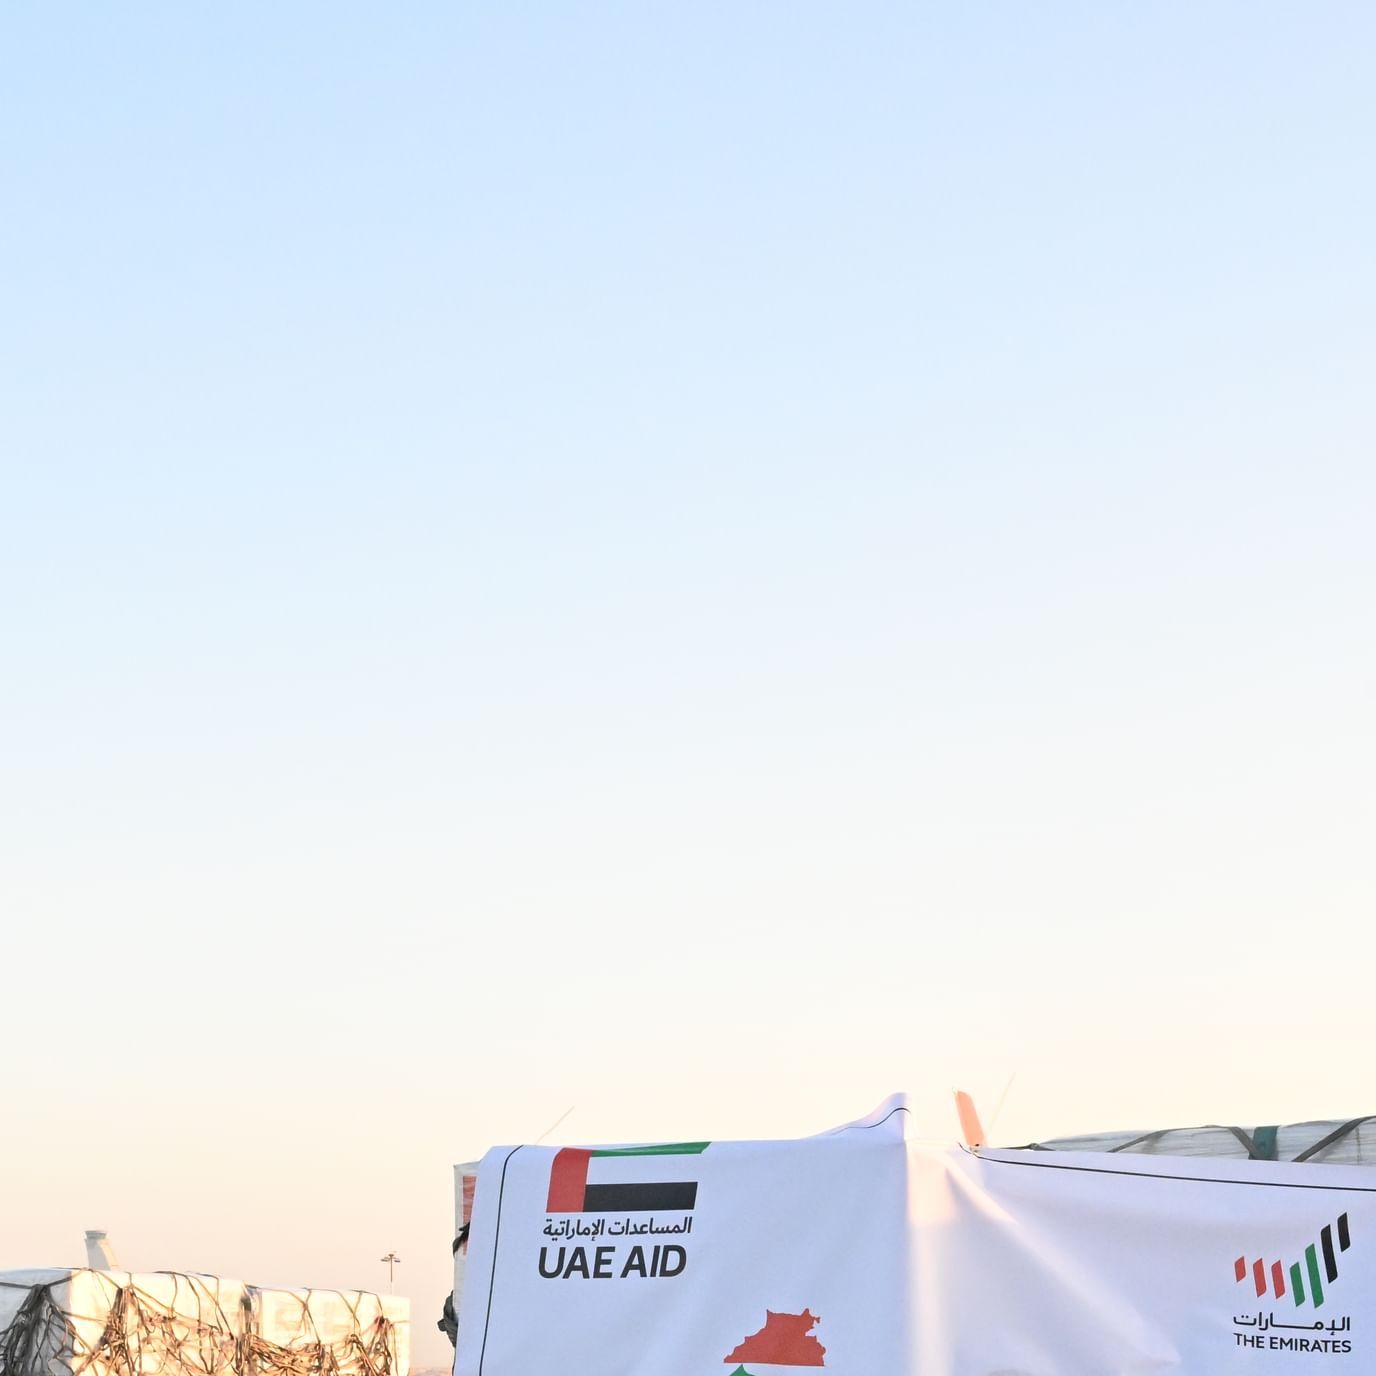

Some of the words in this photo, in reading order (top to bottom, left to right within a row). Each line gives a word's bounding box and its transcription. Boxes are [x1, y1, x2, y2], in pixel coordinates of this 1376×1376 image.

[543, 1218, 606, 1242] الإماراتية
[607, 1216, 693, 1237] المساعدات
[538, 1246, 616, 1279] UAE
[620, 1245, 687, 1278] AID
[1233, 1333, 1265, 1349] THE
[1269, 1336, 1352, 1353] EMIRATES
